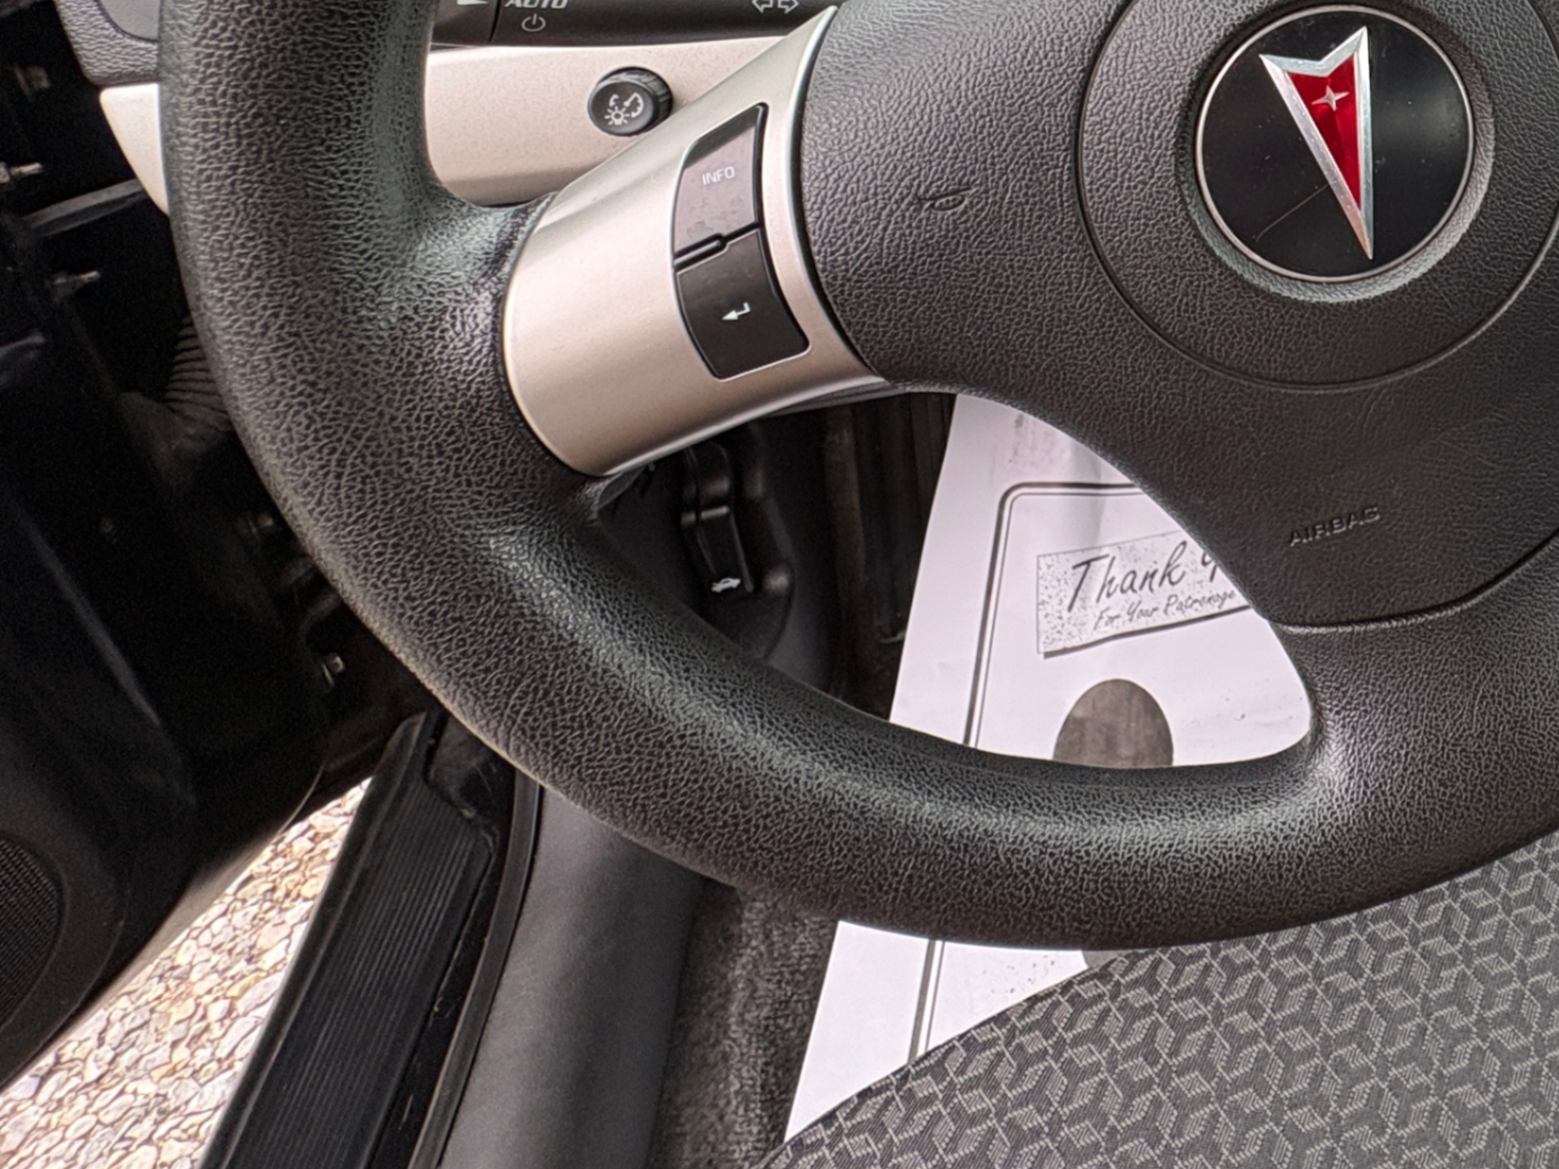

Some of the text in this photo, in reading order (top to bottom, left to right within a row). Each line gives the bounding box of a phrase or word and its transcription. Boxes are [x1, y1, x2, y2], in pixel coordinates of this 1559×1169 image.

[702, 166, 735, 185] INFO
[1288, 505, 1381, 546] AIRBAG
[1067, 540, 1187, 612] Thank
[1093, 589, 1237, 630] For Your Patronage
